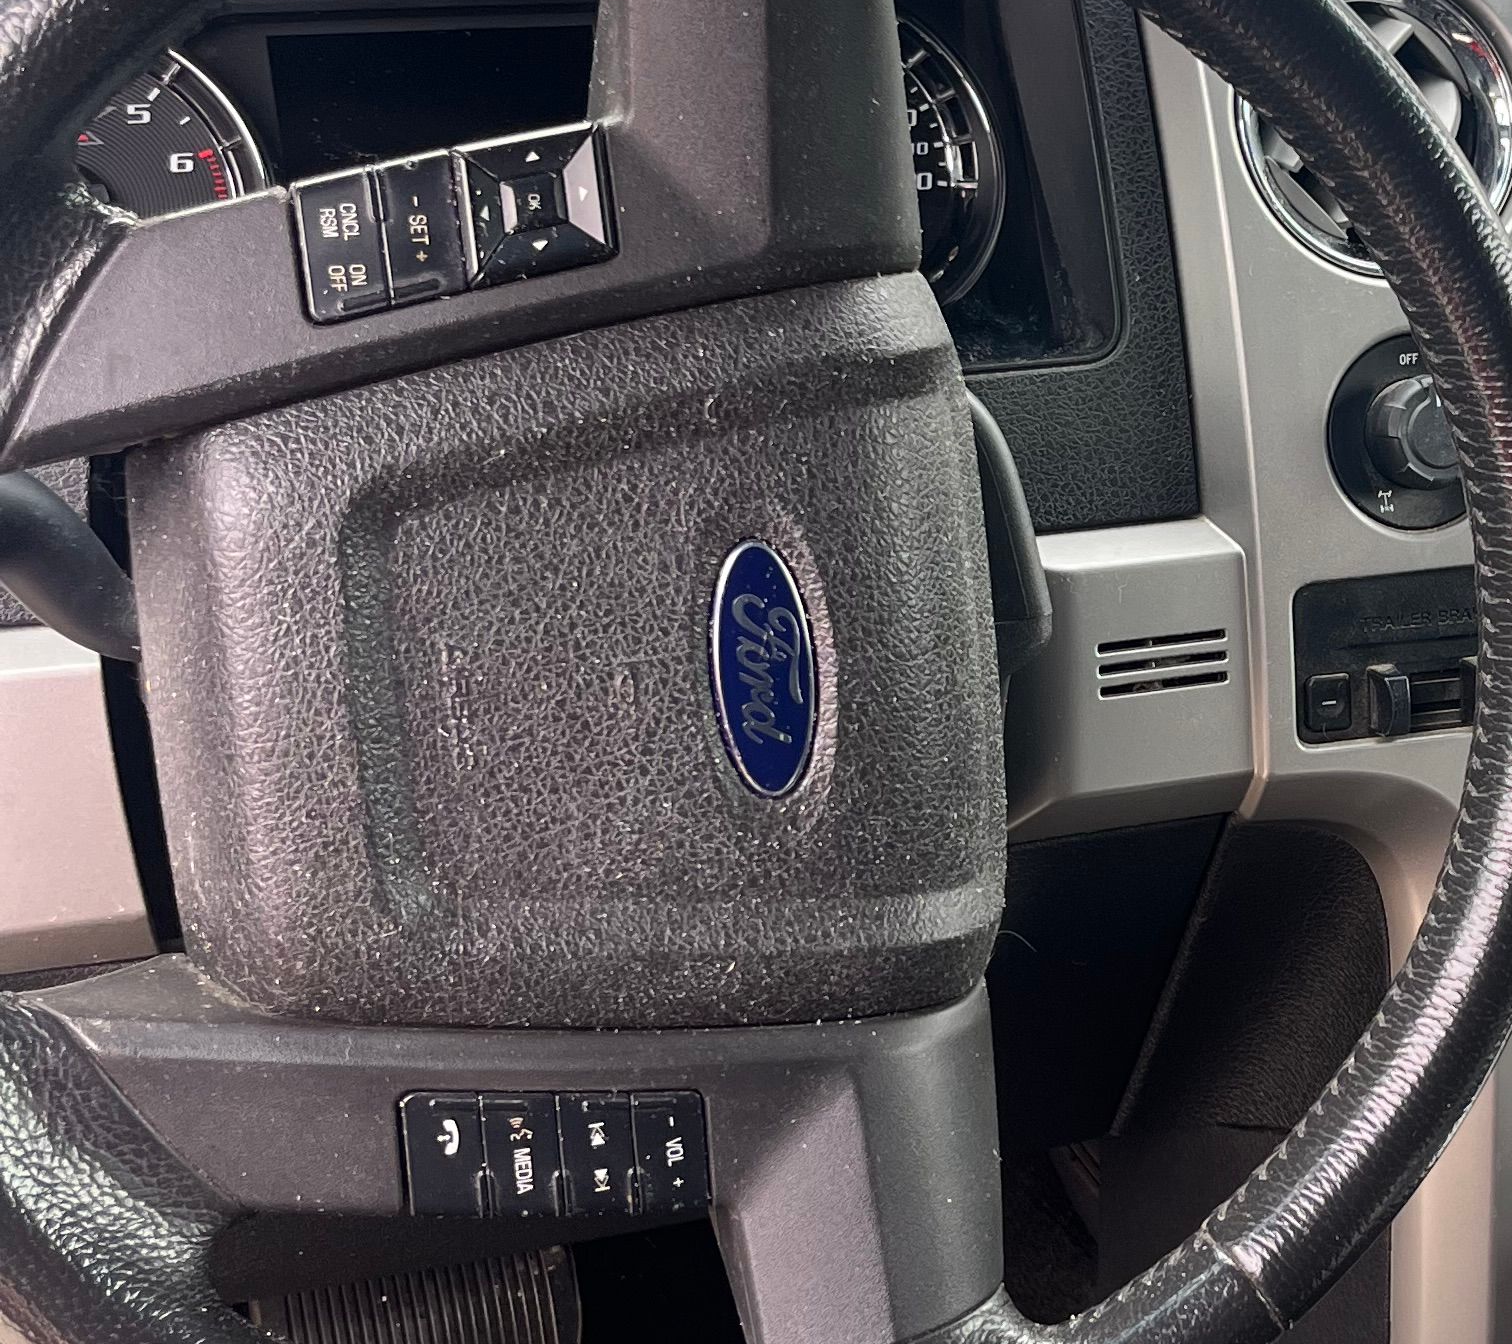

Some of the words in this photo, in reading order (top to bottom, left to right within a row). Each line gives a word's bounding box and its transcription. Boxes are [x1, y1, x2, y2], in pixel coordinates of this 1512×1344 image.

[126, 103, 152, 125] 5
[169, 152, 195, 174] 6
[527, 192, 542, 211] OK
[319, 208, 340, 239] RSM
[339, 202, 362, 241] CNCL
[408, 213, 430, 246] SET
[328, 263, 348, 293] OFF
[349, 262, 368, 287] ON
[1399, 352, 1419, 366] OFF
[1360, 611, 1433, 634] TRAILER
[731, 593, 804, 745] Ford
[665, 1136, 685, 1167] VOL
[513, 1147, 535, 1195] MEDIA
